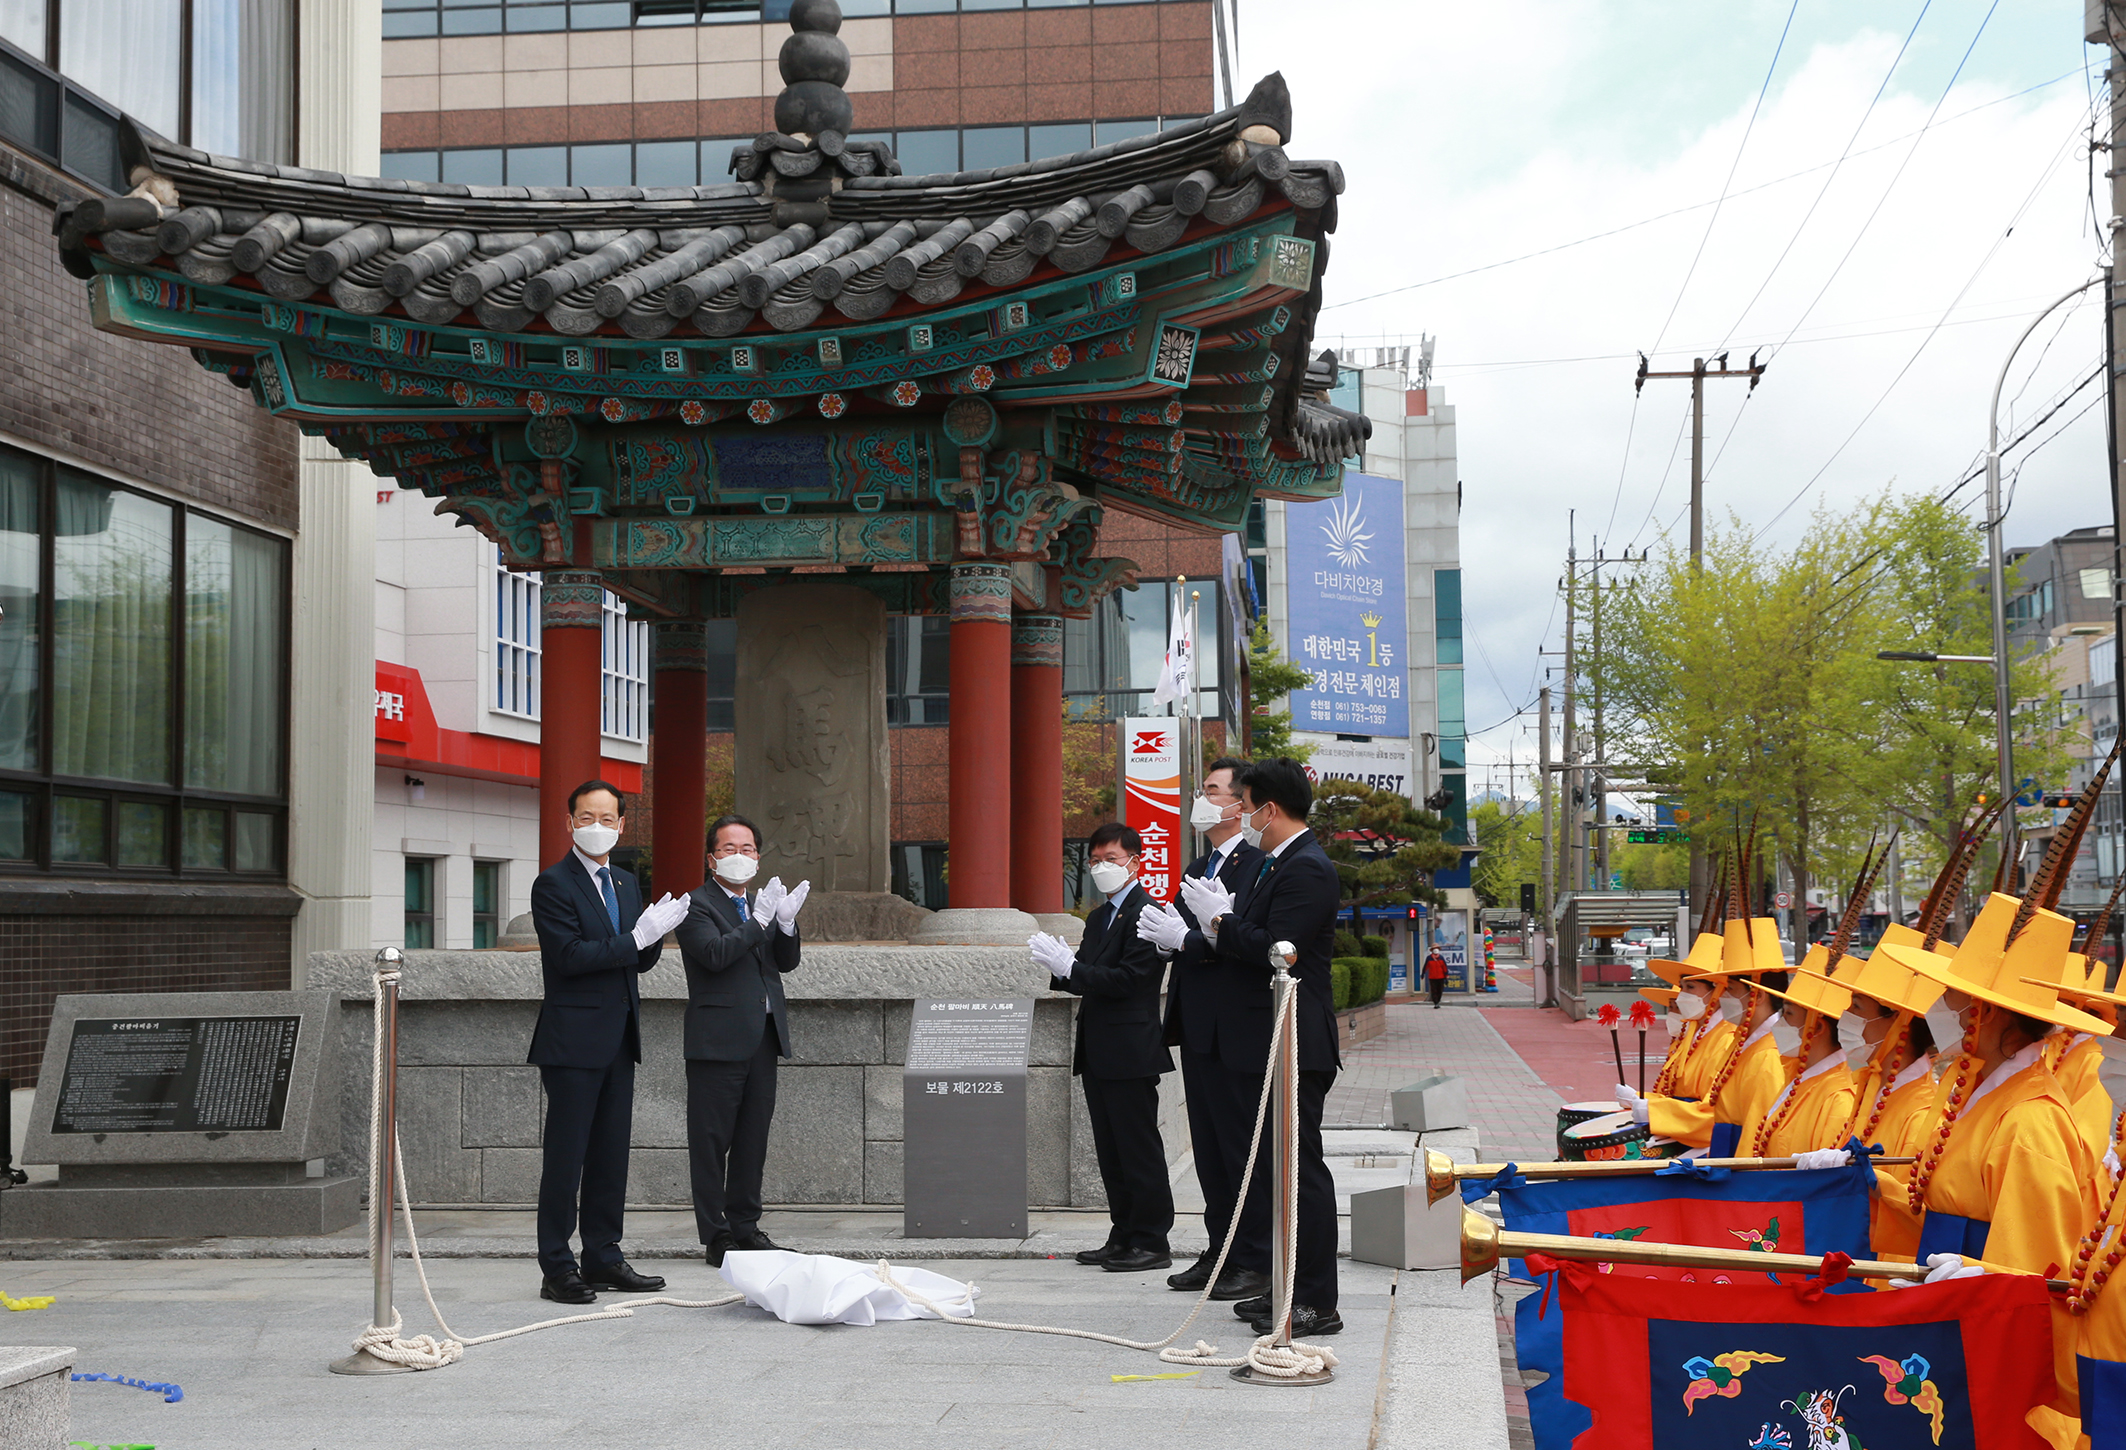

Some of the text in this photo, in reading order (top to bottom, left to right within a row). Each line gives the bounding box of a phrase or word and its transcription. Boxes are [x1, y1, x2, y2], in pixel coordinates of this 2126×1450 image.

[1314, 571, 1383, 596] 다비치안경
[1321, 591, 1336, 599] Davich
[1337, 593, 1351, 601] Optical
[1303, 631, 1394, 667] 대한민국 1등
[1360, 673, 1400, 699] 체인점
[1310, 699, 1331, 710] 순천점
[1351, 702, 1386, 714] 753-0063
[1310, 710, 1331, 720] 연향점
[1351, 712, 1386, 724] 721-1357
[1367, 774, 1404, 793] BEST
[1139, 822, 1170, 909] 순천행
[930, 1003, 945, 1011] 순천
[948, 1003, 970, 1011] 팔마비
[926, 1081, 1004, 1095] 보물 제2122호
